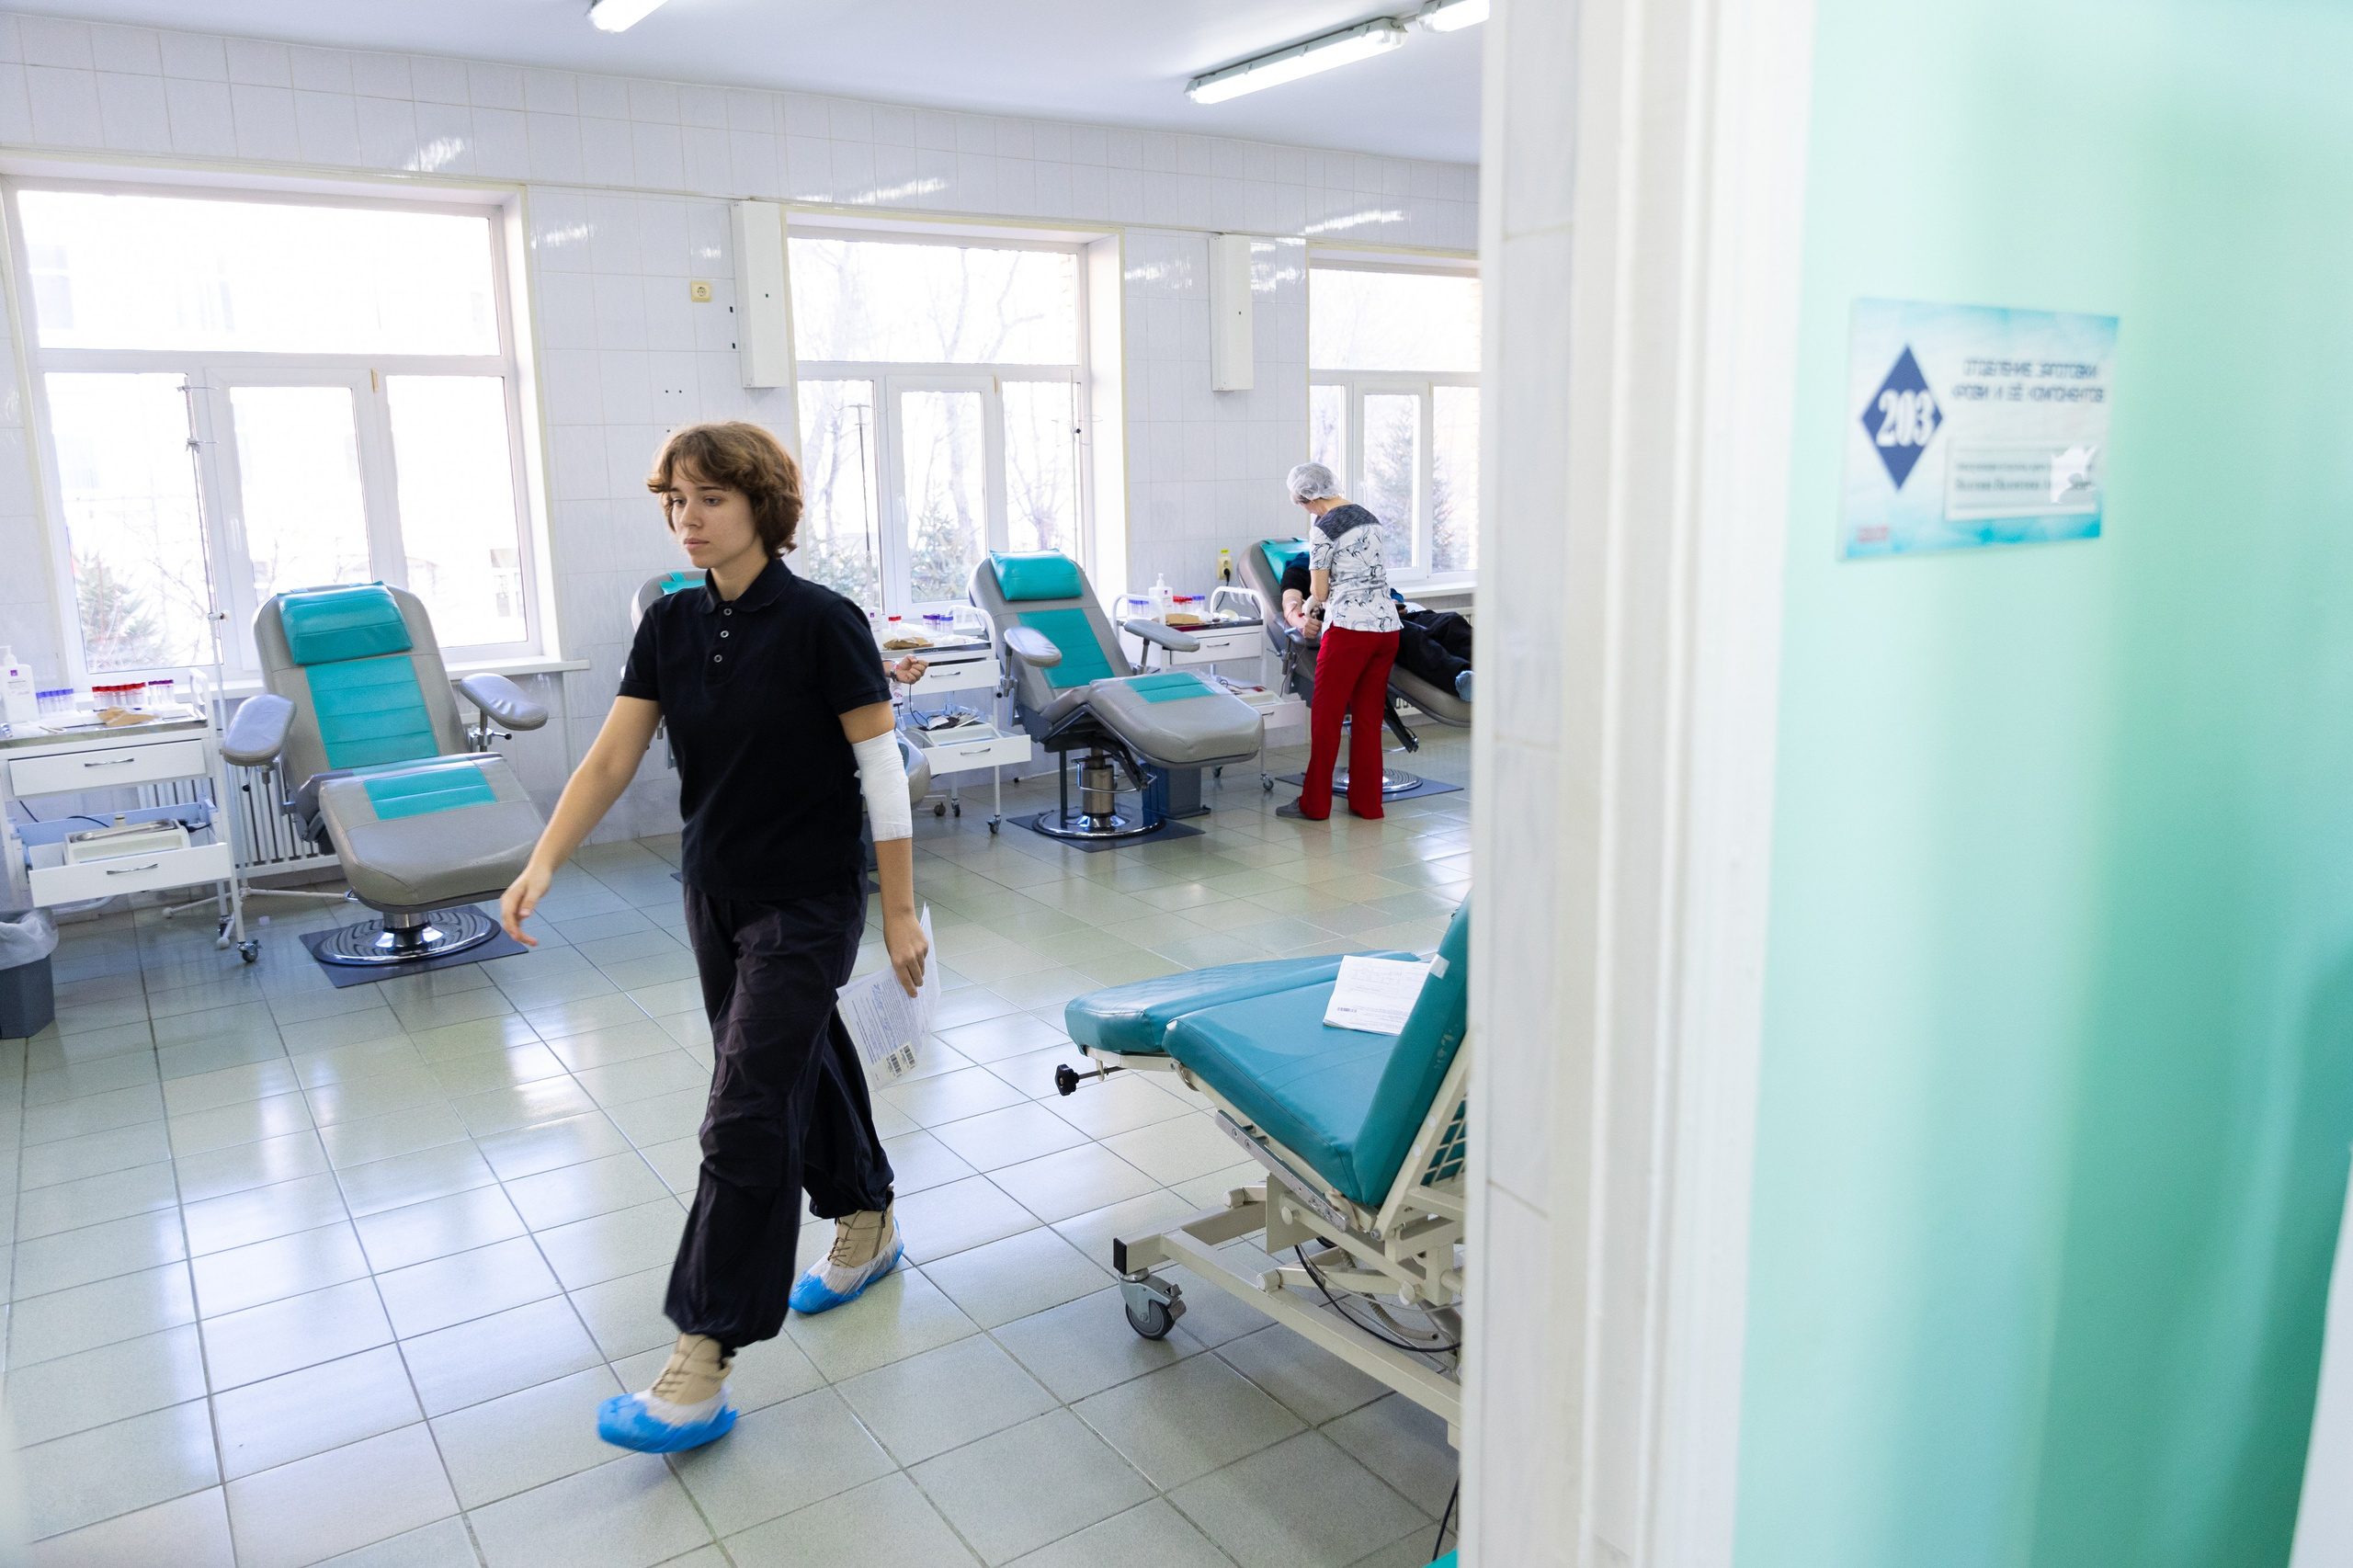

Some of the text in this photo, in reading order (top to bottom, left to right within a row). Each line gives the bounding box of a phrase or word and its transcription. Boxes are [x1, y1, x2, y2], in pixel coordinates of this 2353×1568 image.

[1962, 358, 2097, 379] ОТДЕЛЕНИЕ ЗАГОТОВКИ
[1950, 384, 1988, 401] КРОВИ
[1993, 384, 2003, 401] И
[2028, 385, 2104, 403] КОМПОНЕНТОВ
[1876, 388, 1931, 448] 203
